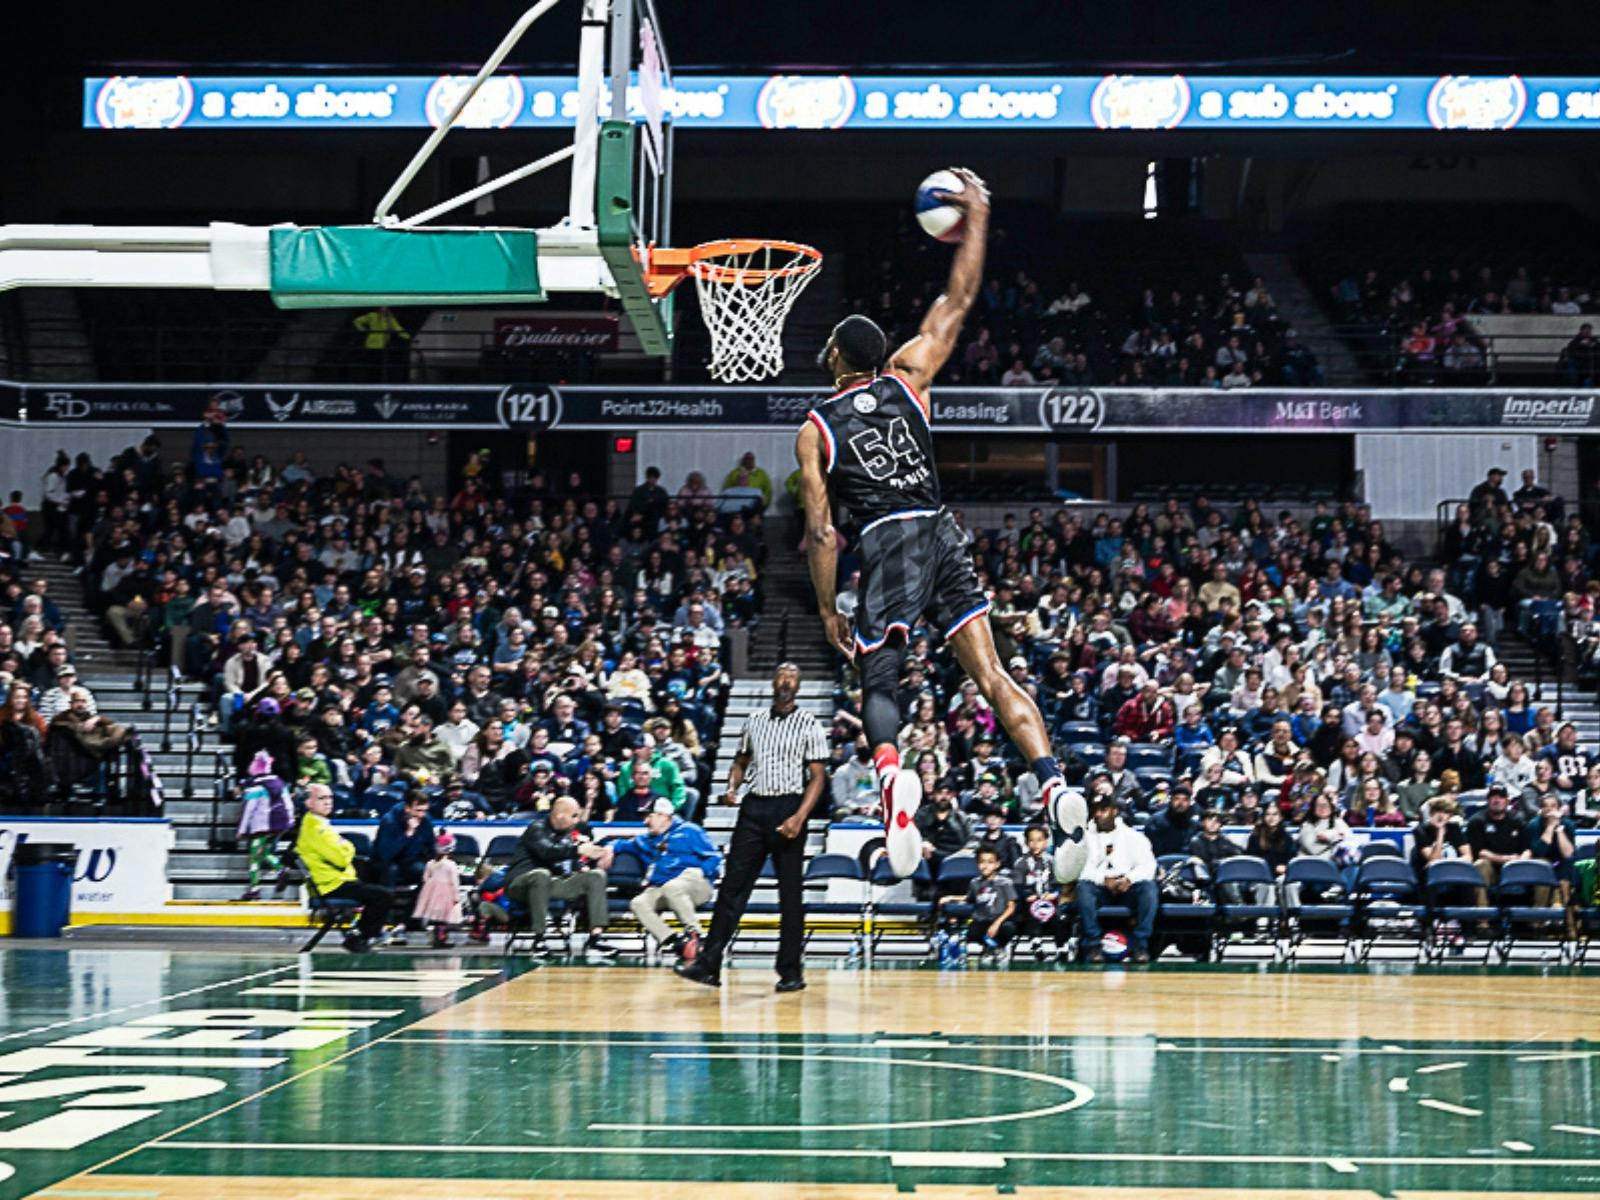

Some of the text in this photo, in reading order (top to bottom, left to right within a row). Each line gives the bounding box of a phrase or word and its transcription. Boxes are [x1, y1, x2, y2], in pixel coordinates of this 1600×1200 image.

[202, 92, 224, 117] a
[231, 85, 289, 116] sub
[533, 92, 555, 117] a
[865, 92, 887, 118] a
[894, 85, 953, 118] sub
[1200, 92, 1222, 117] a
[1230, 85, 1288, 117] sub
[1537, 92, 1558, 117] a
[500, 325, 611, 346] Budweiser
[504, 394, 549, 421] 121
[601, 399, 723, 416] Point32Health
[932, 401, 1009, 423] Leasing
[1048, 394, 1096, 424] 122
[1274, 401, 1361, 420] M&T Bank
[1502, 396, 1595, 419] Imperial
[848, 416, 926, 482] 54
